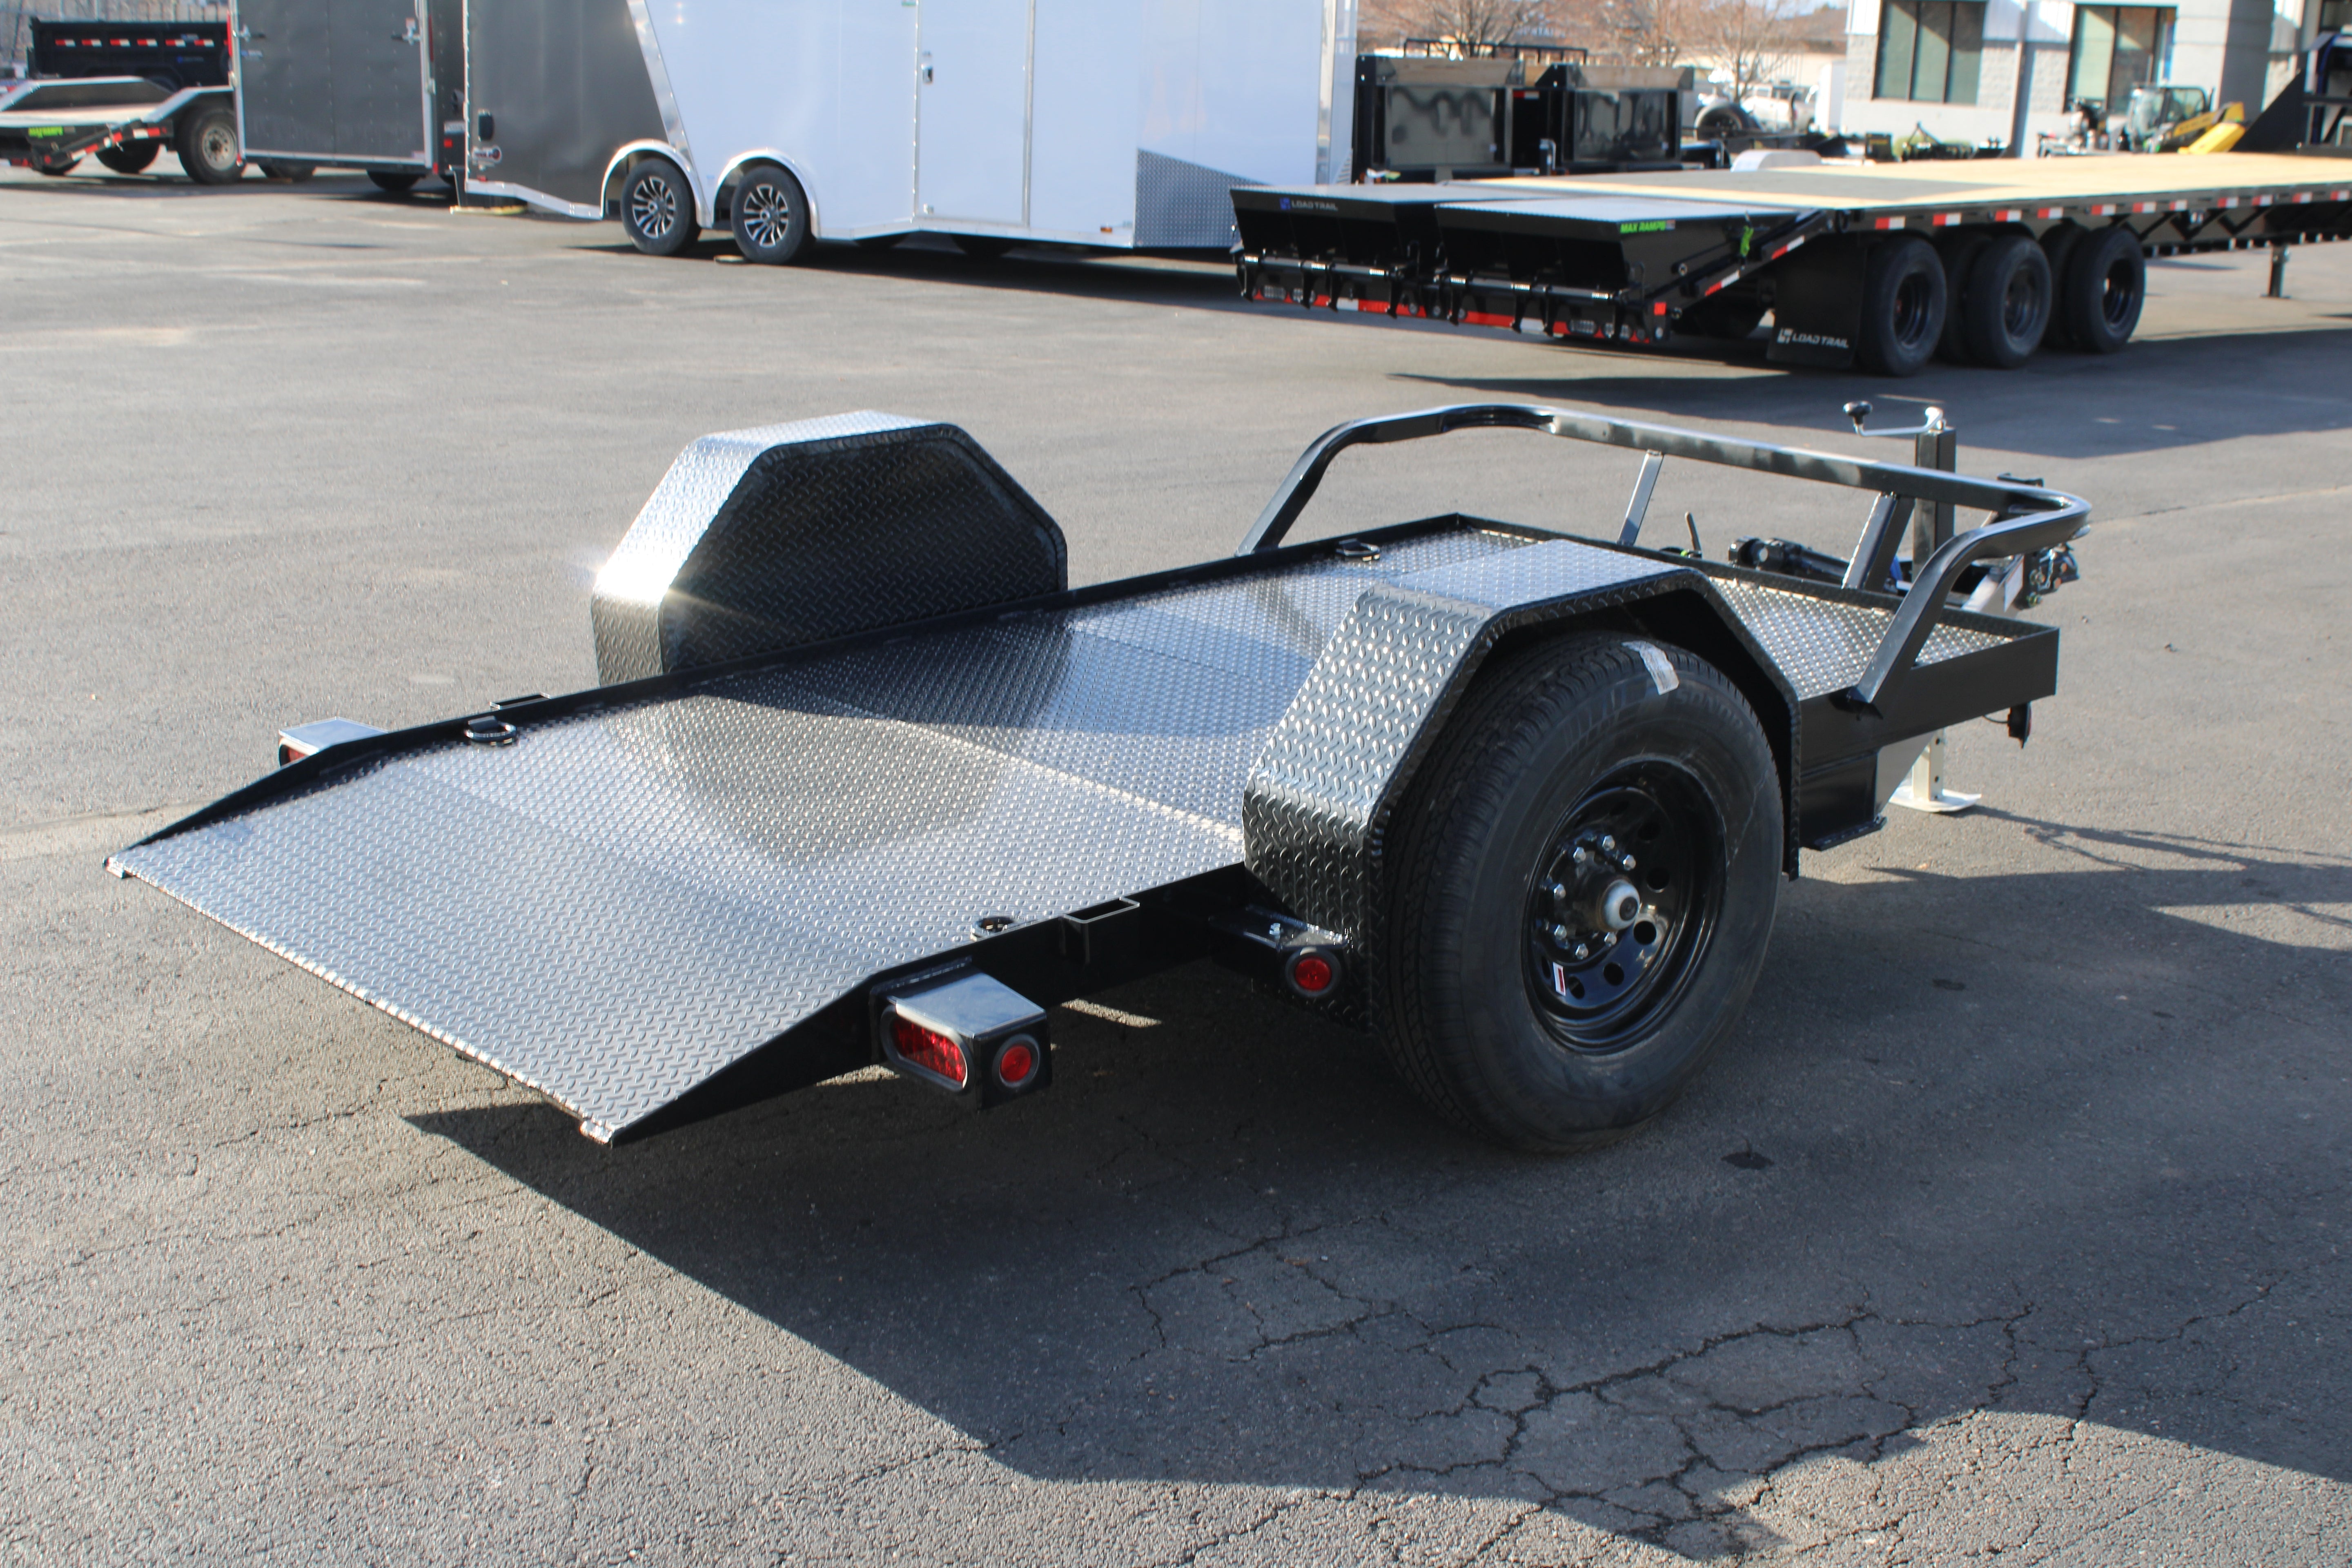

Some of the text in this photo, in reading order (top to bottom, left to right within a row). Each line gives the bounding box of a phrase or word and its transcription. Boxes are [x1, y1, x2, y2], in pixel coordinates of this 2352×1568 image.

[1291, 200, 1339, 212] LOAD TRAIL
[1620, 223, 1639, 234] MAX
[1792, 333, 1849, 349] LOAD TRAIL
